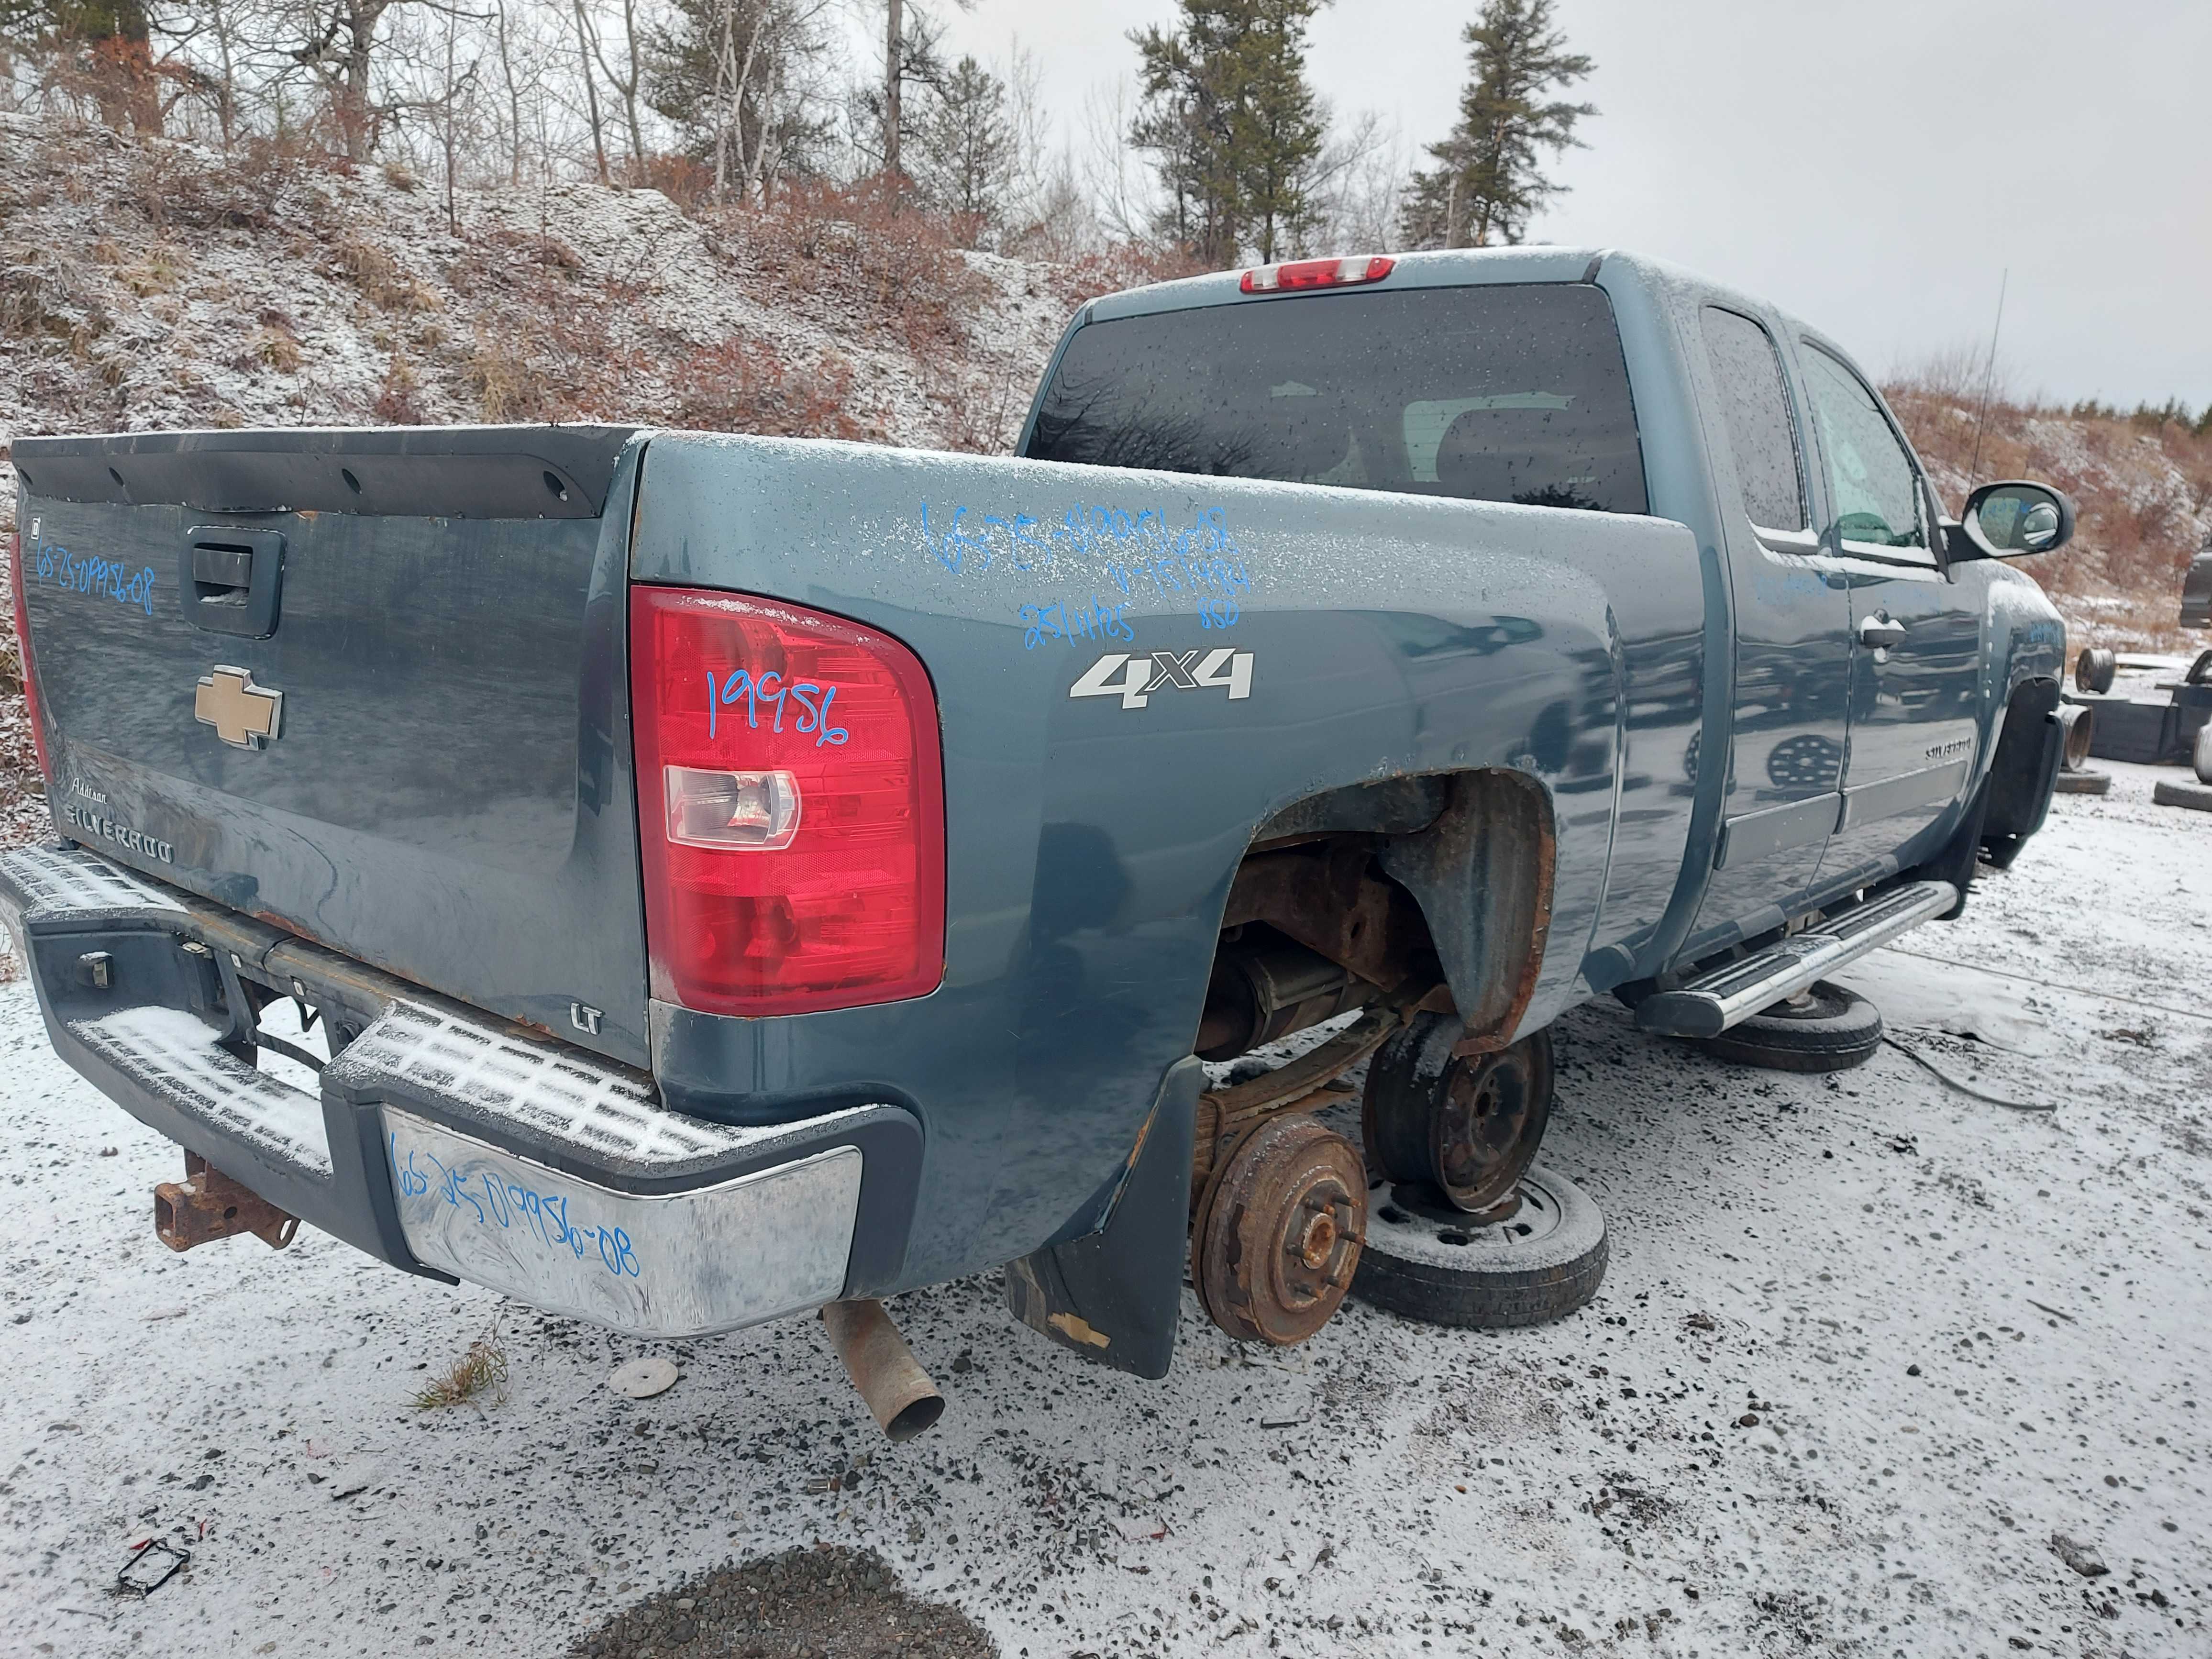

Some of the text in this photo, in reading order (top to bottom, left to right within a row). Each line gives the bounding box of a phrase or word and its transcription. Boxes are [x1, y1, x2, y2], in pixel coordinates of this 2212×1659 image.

[708, 668, 849, 747] 19956
[72, 777, 108, 805] Addison
[66, 804, 175, 863] SILVERADO
[571, 1002, 605, 1036] LT
